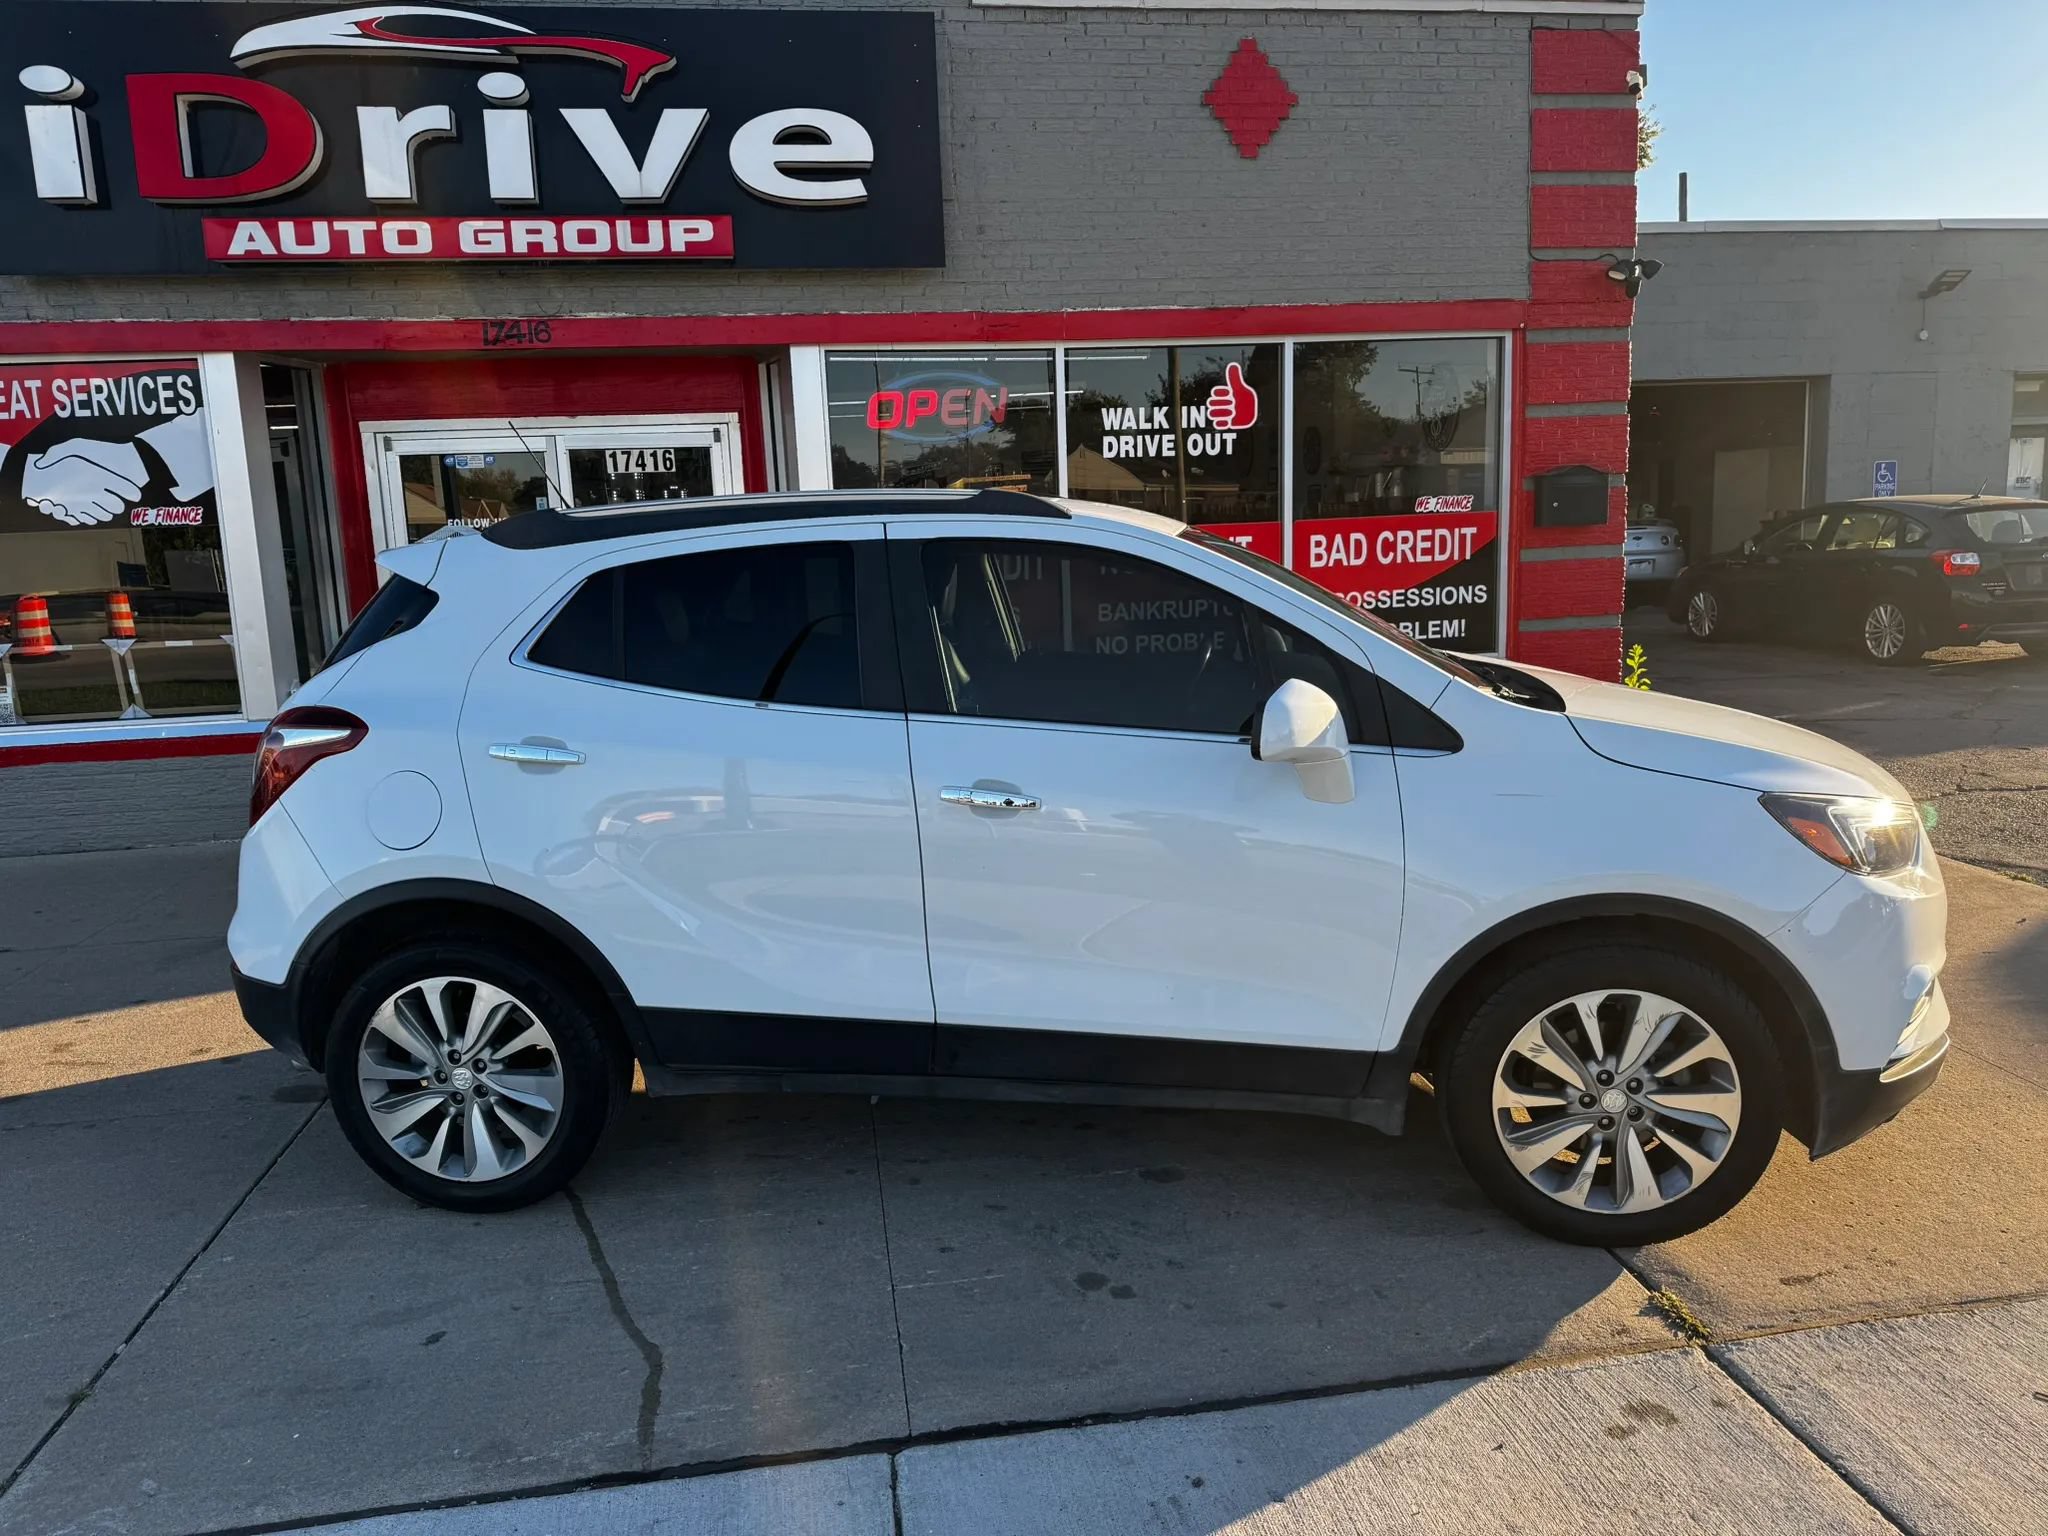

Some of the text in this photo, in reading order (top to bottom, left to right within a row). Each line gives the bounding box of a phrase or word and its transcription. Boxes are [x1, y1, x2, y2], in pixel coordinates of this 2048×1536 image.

[18, 63, 875, 205] iDrive
[226, 216, 716, 256] AUTO GROUP
[482, 319, 552, 346] 17416
[52, 374, 197, 418] SERVICES
[866, 387, 1008, 430] OPEN
[1101, 406, 1206, 431] WALK IN
[1102, 432, 1237, 459] DRIVE OUT
[608, 449, 675, 473] 17416
[131, 506, 203, 526] WE FINANCE
[1415, 494, 1474, 512] WE FINANCE
[447, 518, 490, 529] FOLLOW
[1310, 527, 1478, 568] BAD CREDIT
[1335, 584, 1488, 610] OSSESSIONS
[1388, 618, 1467, 640] BLEM!
[1096, 635, 1129, 655] NO
